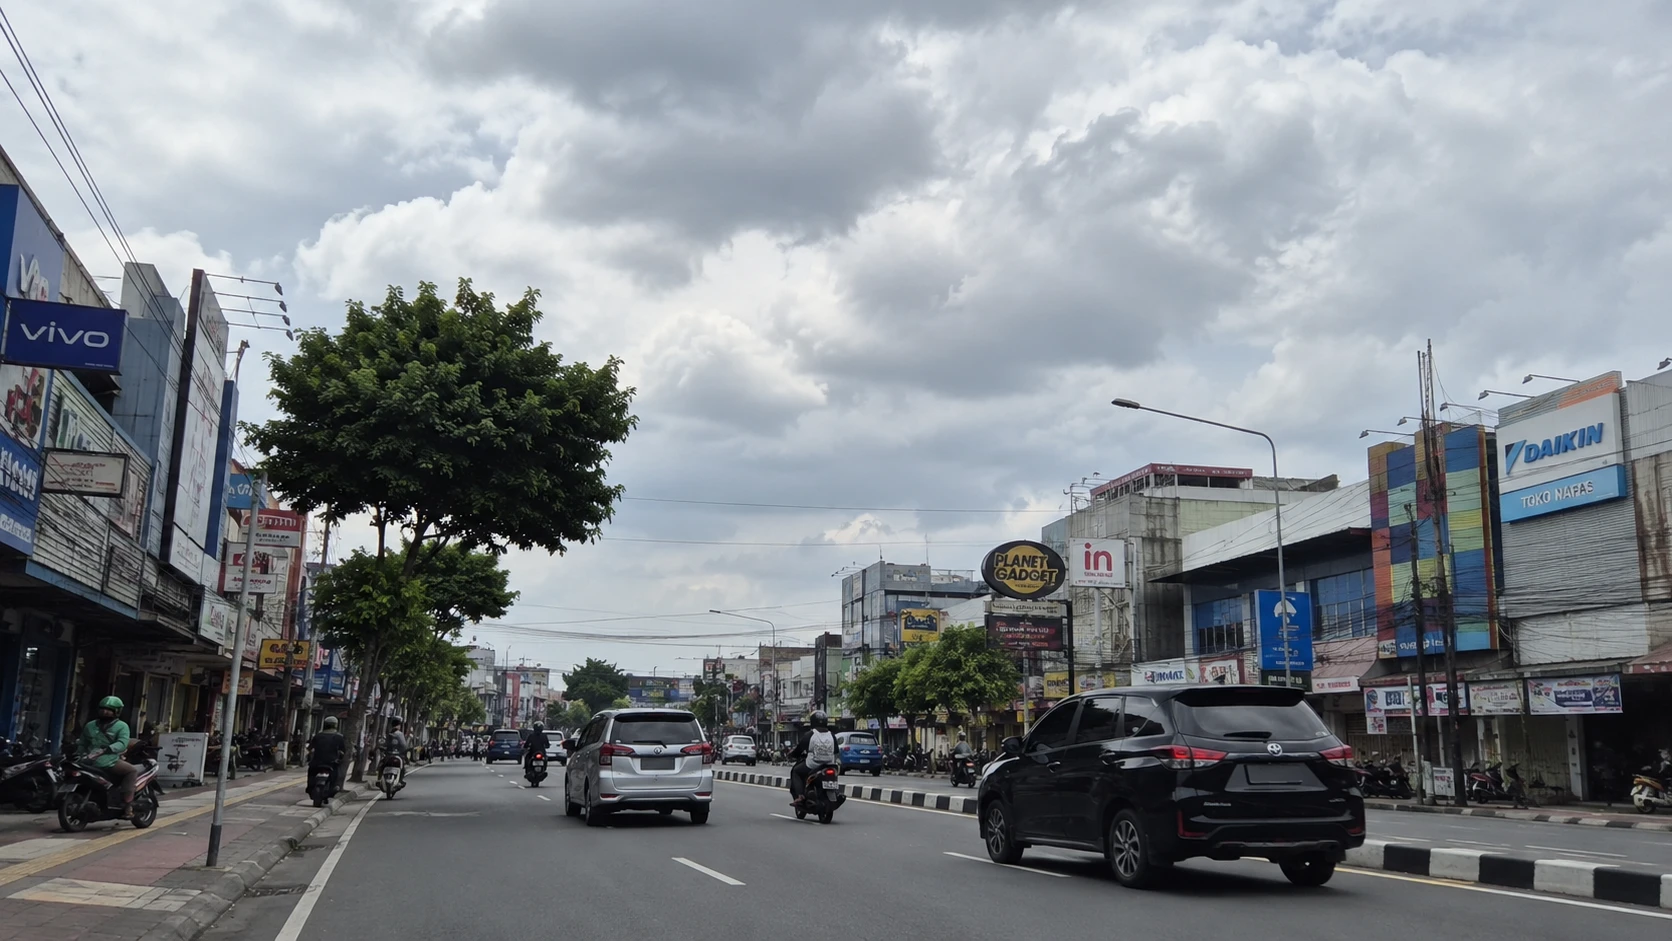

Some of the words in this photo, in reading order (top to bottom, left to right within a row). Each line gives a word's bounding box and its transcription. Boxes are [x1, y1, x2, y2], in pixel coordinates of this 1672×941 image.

[20, 321, 109, 348] vivo
[1524, 423, 1604, 463] DAIKIN
[1520, 490, 1551, 508] TOKO
[995, 553, 1048, 569] PLANET
[1084, 542, 1113, 572] in
[995, 568, 1059, 586] GADGET
